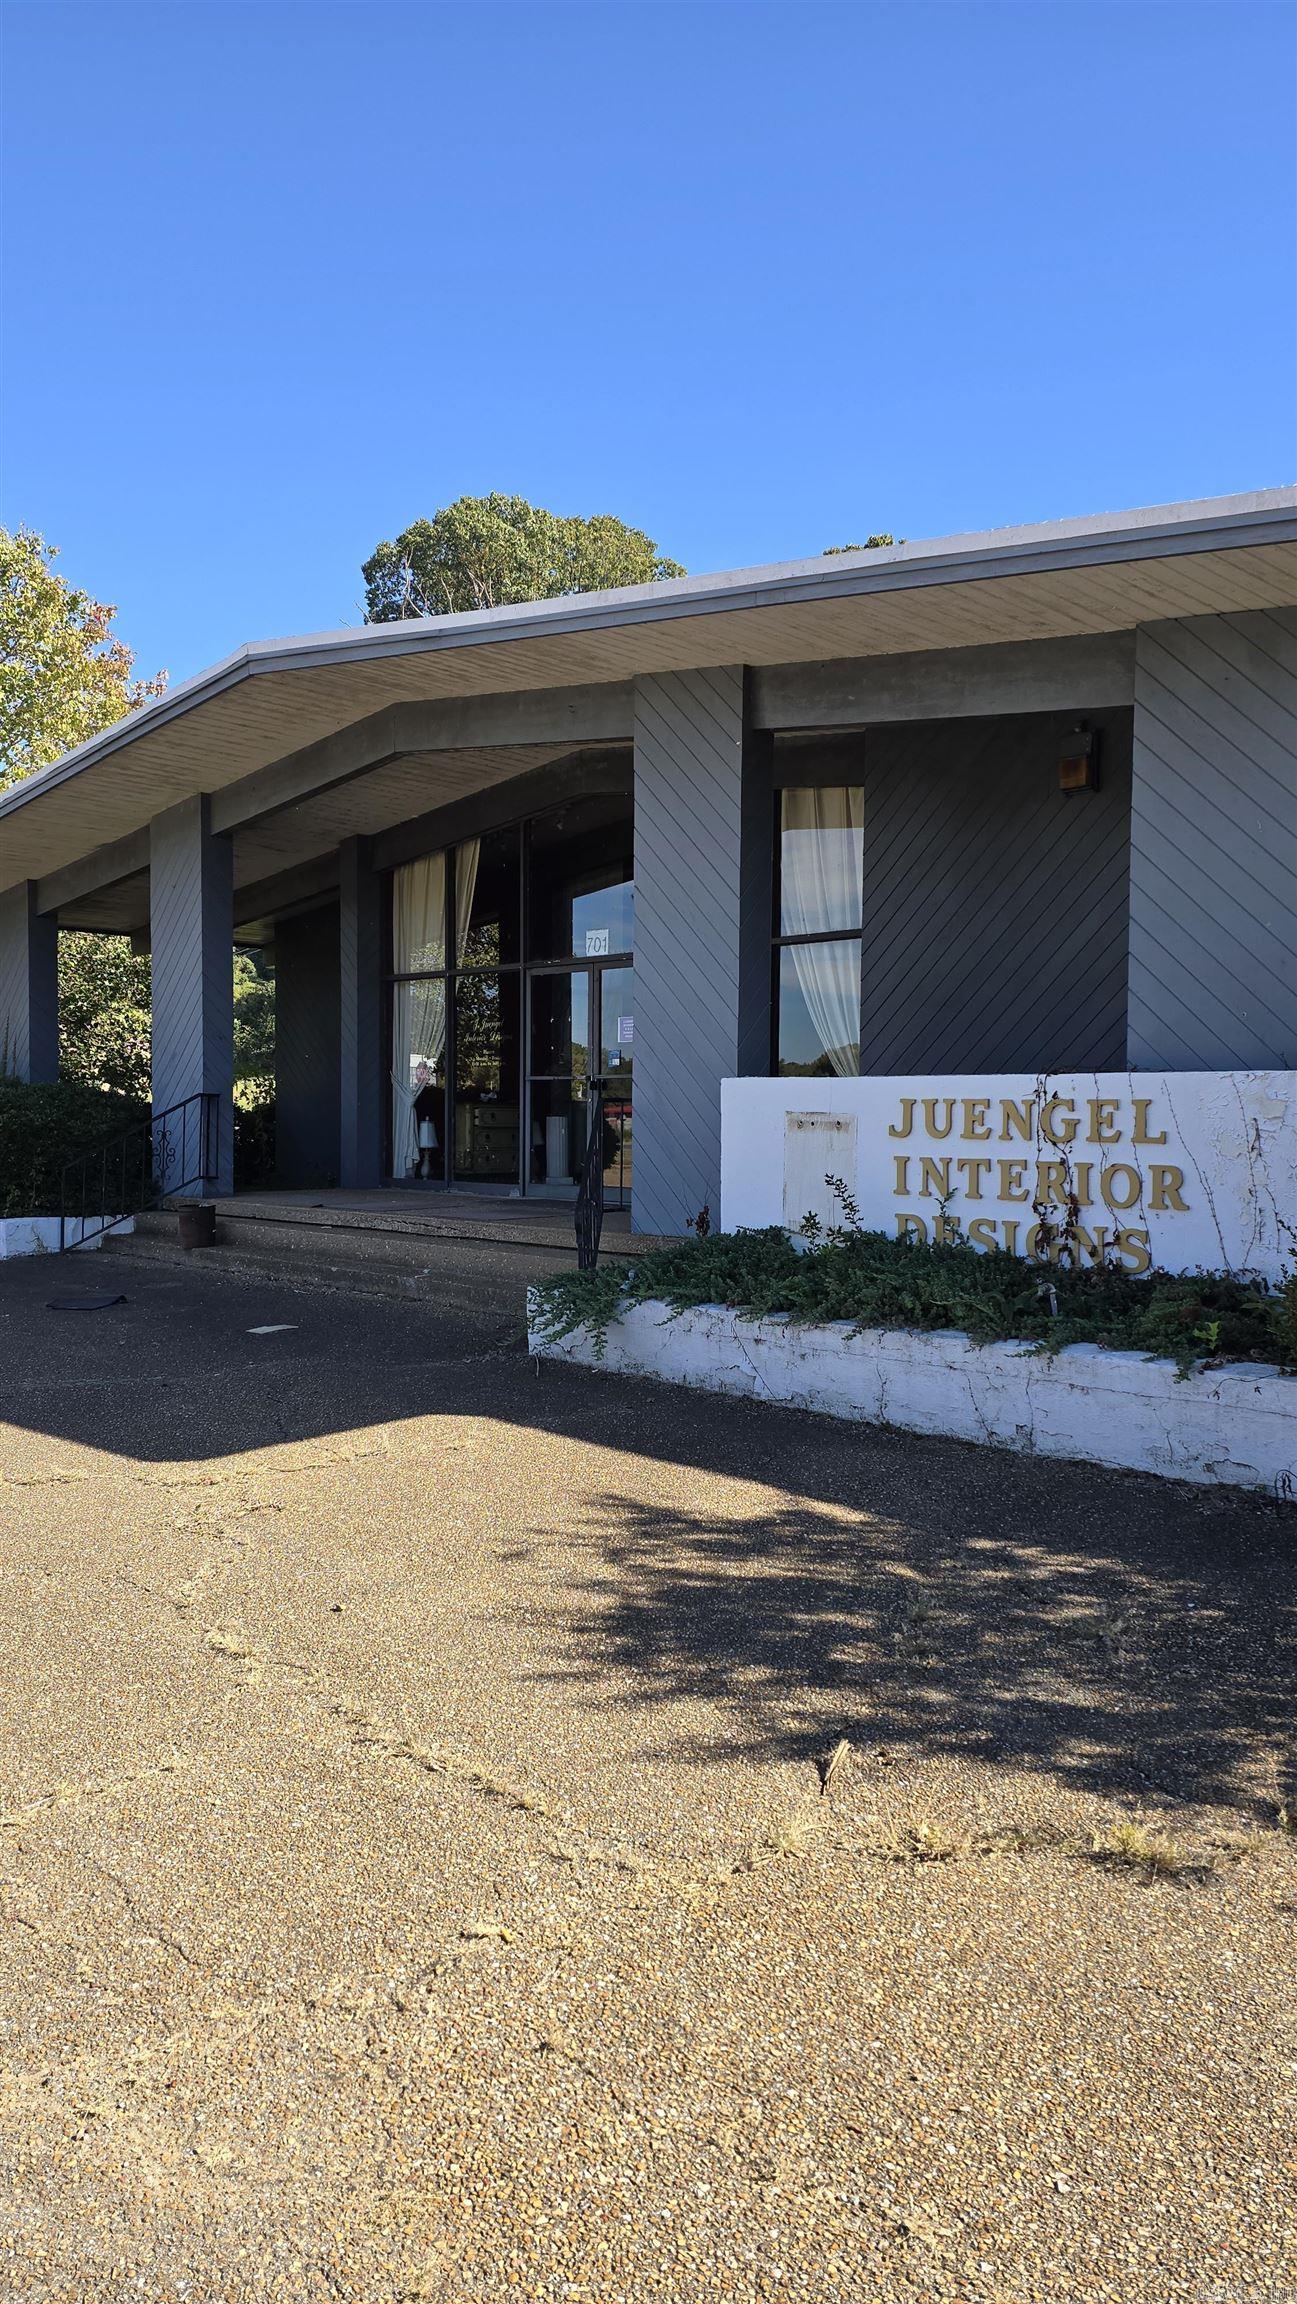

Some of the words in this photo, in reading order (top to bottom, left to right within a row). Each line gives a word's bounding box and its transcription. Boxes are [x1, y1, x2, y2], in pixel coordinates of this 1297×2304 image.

[587, 937, 607, 953] 701
[888, 1098, 1167, 1145] JUENGEL
[893, 1155, 1190, 1211] INTERIOR
[895, 1213, 1152, 1274] DESIGNS
